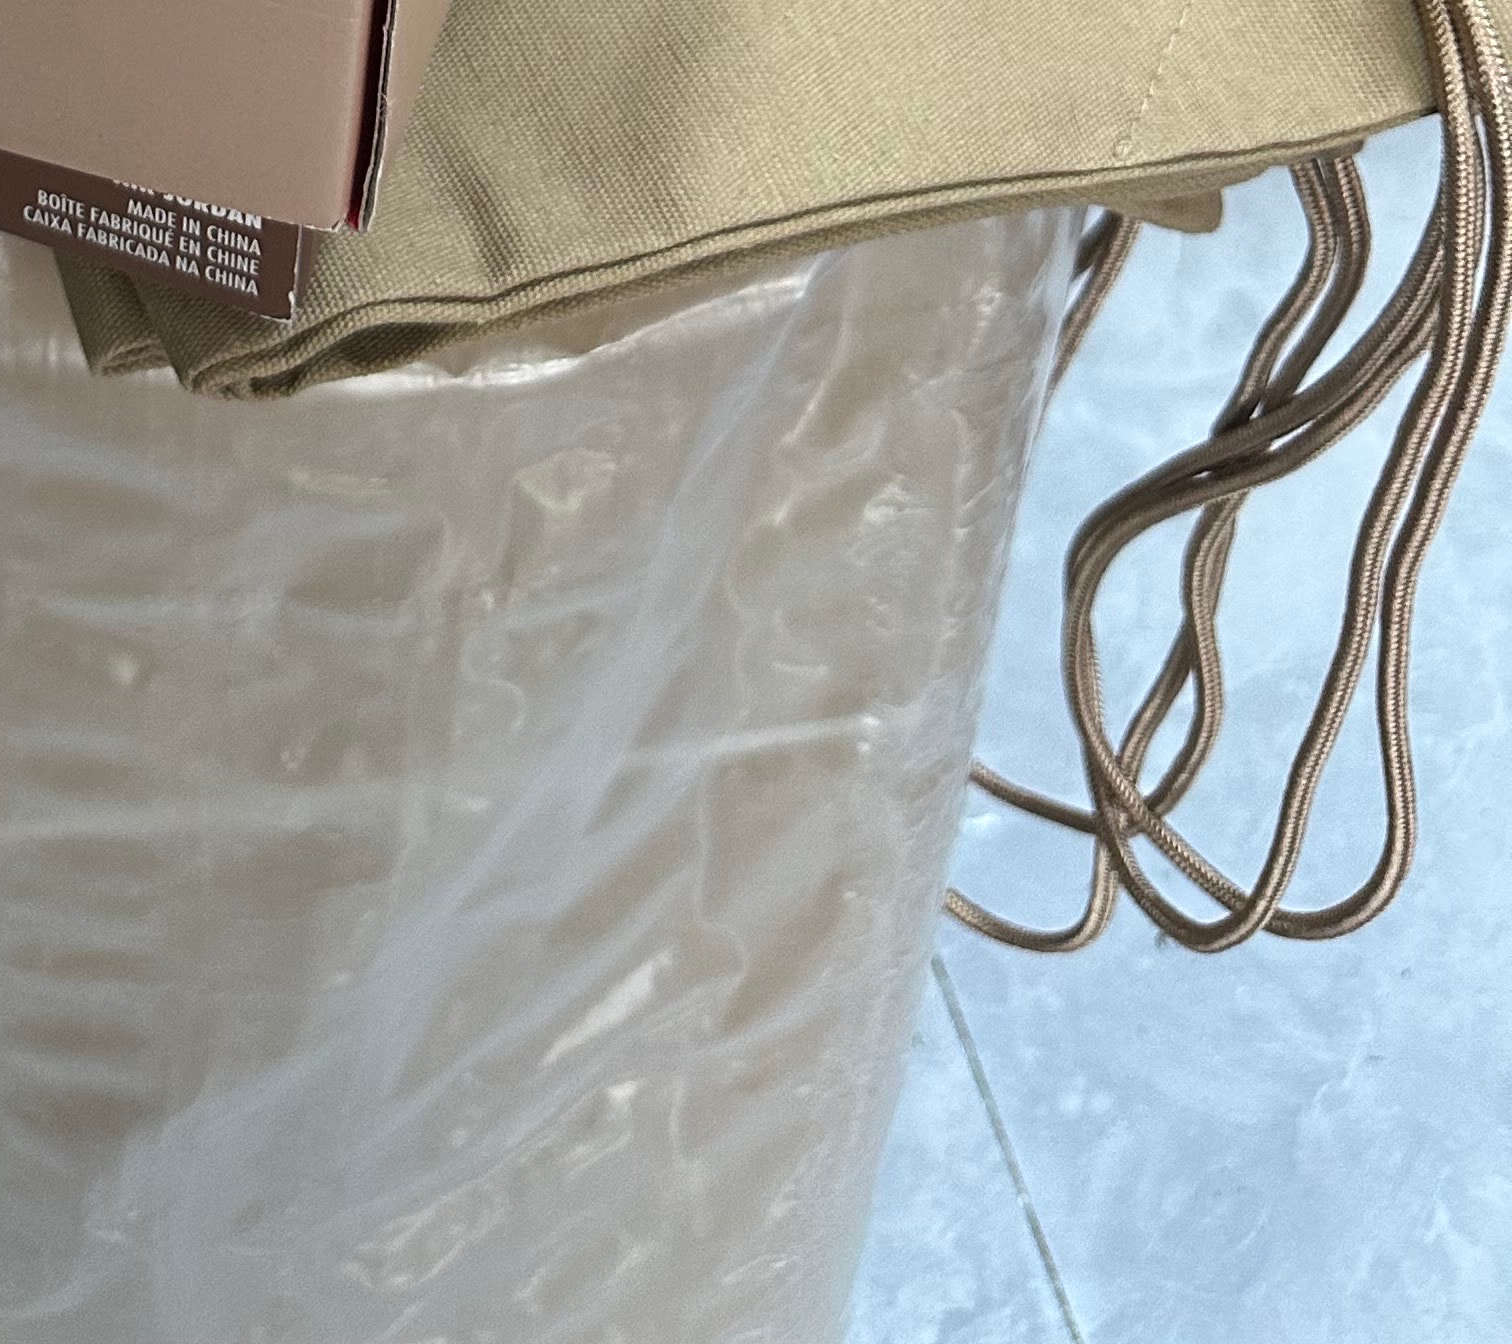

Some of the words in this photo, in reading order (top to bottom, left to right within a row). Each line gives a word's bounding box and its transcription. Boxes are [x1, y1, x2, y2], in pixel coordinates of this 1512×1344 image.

[22, 204, 73, 235] CAIXA
[77, 222, 171, 267] FABRICADA
[175, 254, 201, 277] NA
[204, 265, 260, 297] CHINA
[37, 189, 85, 219] BOÎTE
[90, 206, 174, 248] FABRIQUÉ
[179, 235, 201, 257] EN
[206, 245, 260, 276] CHINE
[127, 198, 177, 228] MADE
[182, 215, 201, 236] IN
[206, 224, 262, 256] CHINA
